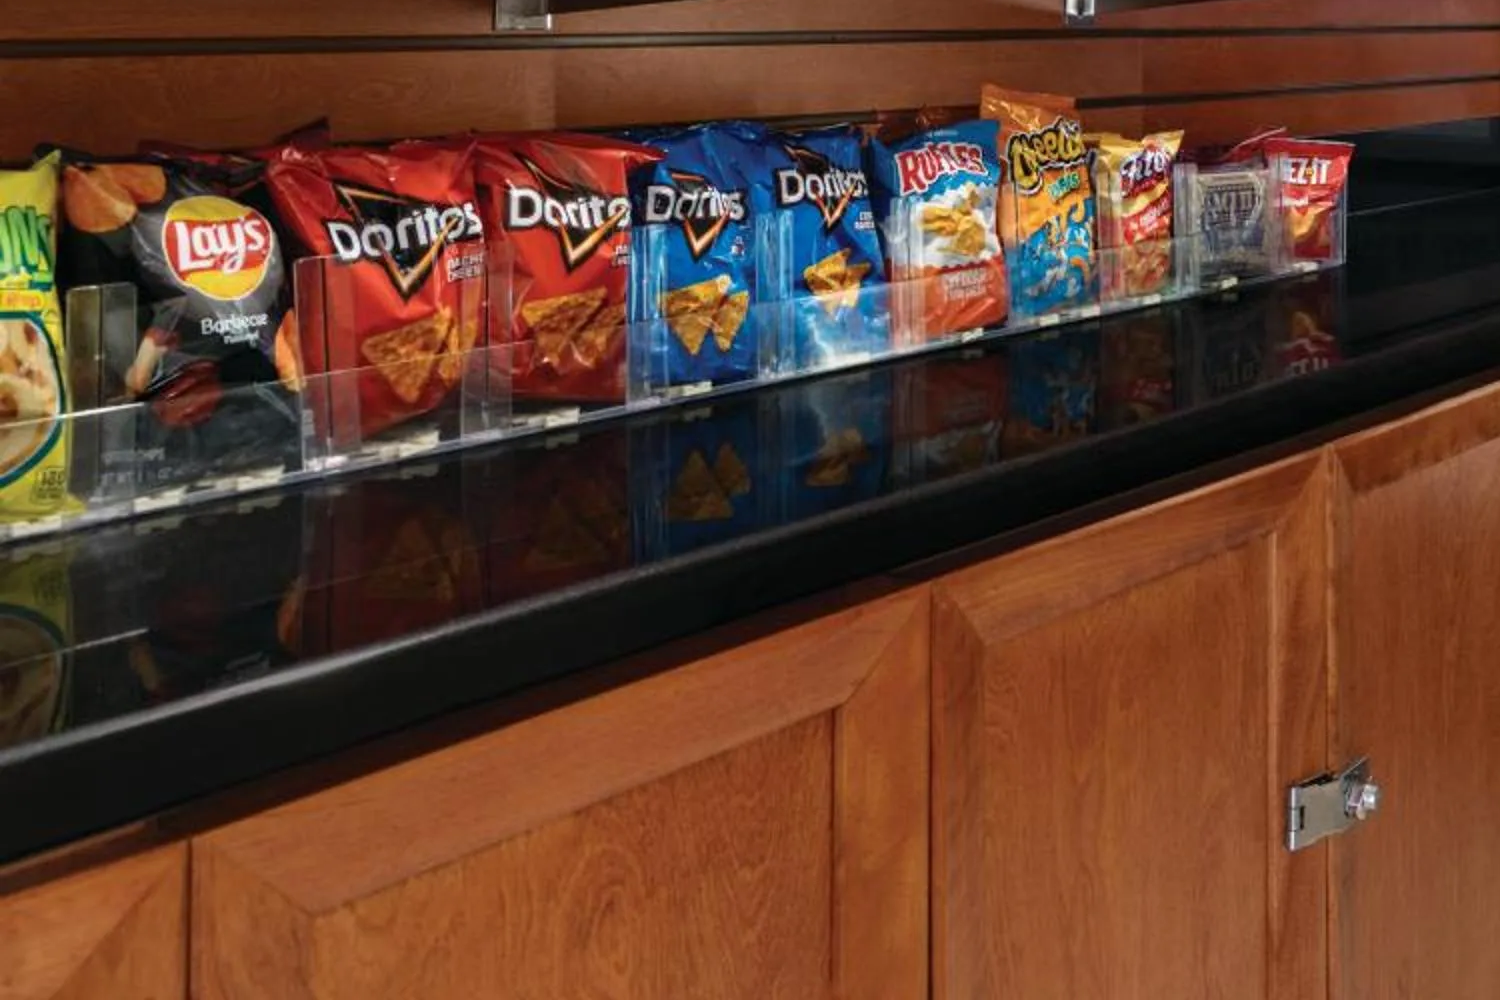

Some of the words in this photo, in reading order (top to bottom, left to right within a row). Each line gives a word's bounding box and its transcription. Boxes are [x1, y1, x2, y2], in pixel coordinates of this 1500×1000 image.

[895, 141, 988, 196] RUFFLES
[506, 186, 632, 230] Dorito
[645, 184, 746, 222] Doritos
[174, 216, 265, 275] Lay's
[327, 202, 483, 262] Doritos
[200, 312, 269, 337] Barbecue
